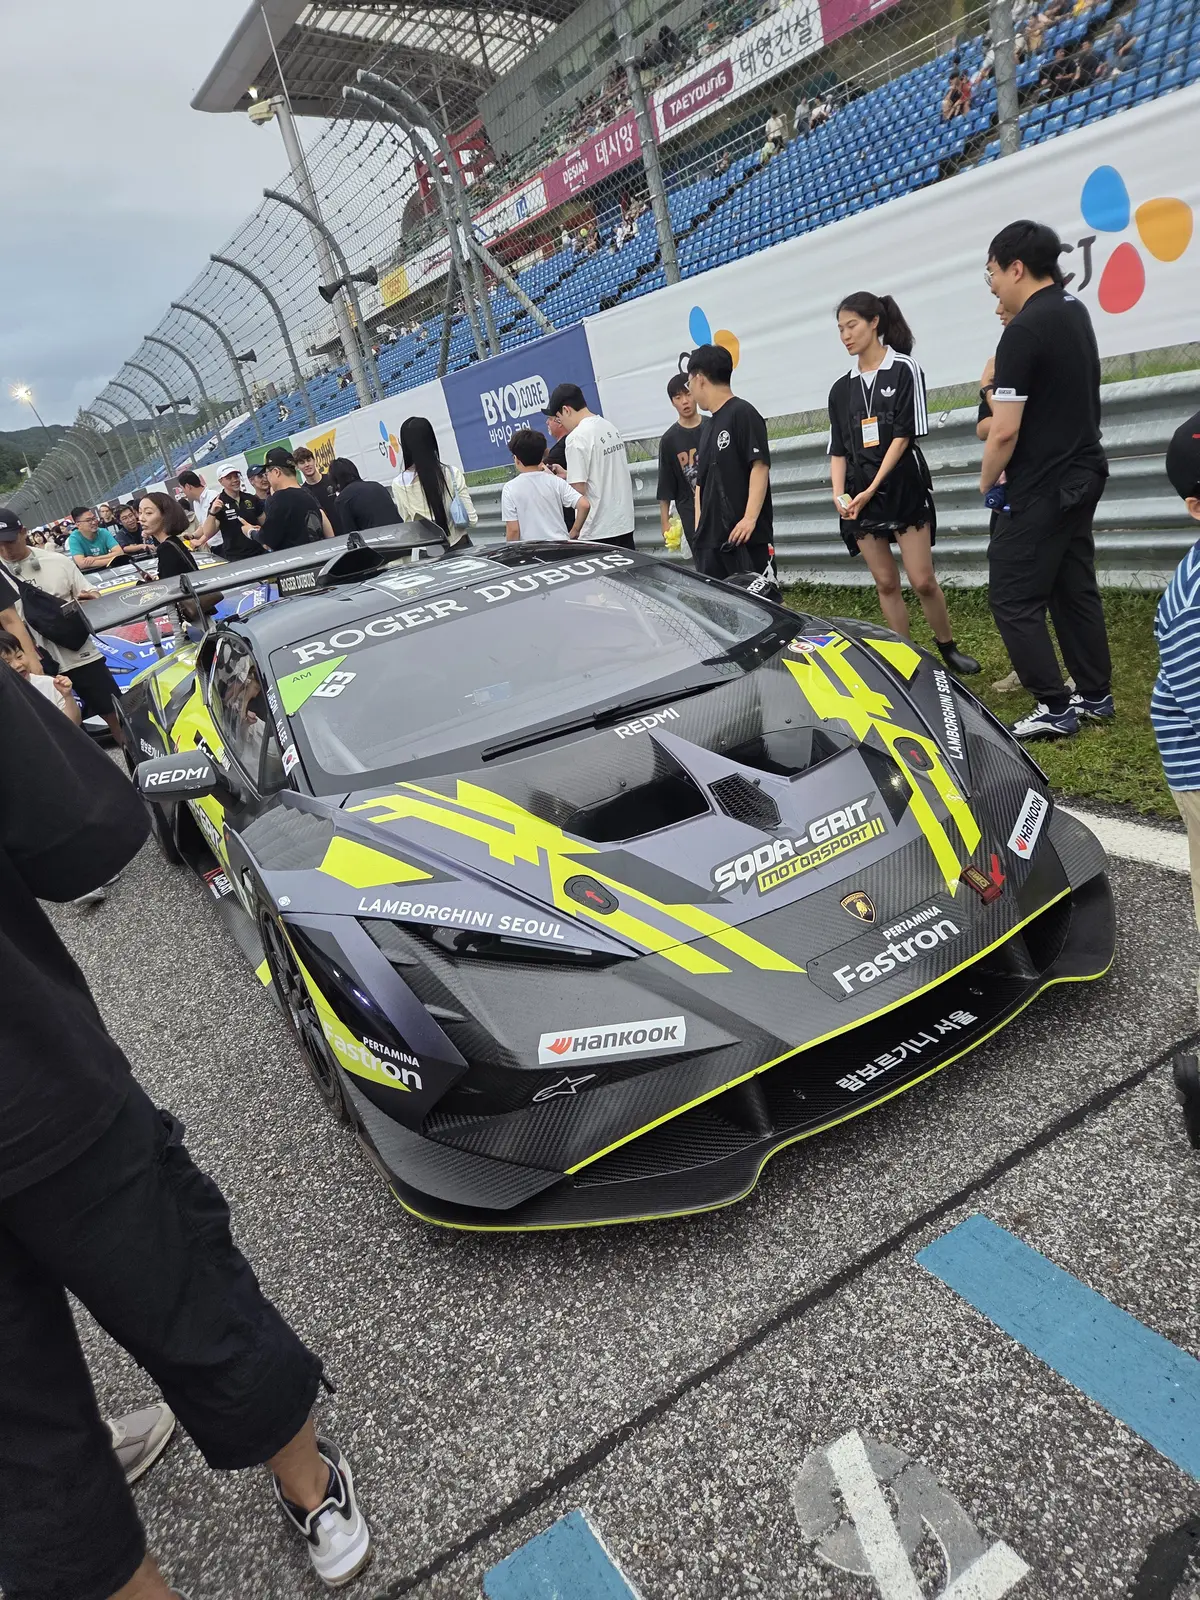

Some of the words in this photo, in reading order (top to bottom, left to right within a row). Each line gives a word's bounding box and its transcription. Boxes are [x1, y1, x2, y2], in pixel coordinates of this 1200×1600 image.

[739, 7, 813, 76] 태영건설
[669, 70, 727, 117] TAEYOUNG
[594, 122, 633, 167] 데시앙
[563, 157, 589, 185] DESIAN
[480, 384, 521, 426] BYO
[520, 382, 545, 409] CORE
[280, 577, 298, 592] ROGER
[297, 572, 316, 590] DUBUIS
[292, 598, 469, 665] ROGER
[473, 553, 635, 603] DUBUIS
[292, 671, 312, 683] AM
[311, 671, 357, 698] 63
[936, 669, 950, 696] SEOUL
[613, 707, 680, 740] REDMI
[939, 693, 964, 760] LAMBORGHINI
[145, 766, 209, 788] REDMI
[760, 825, 868, 891] MOTORSPORT
[357, 897, 493, 927] LAMBORGHINI
[498, 916, 565, 940] SEOUL
[882, 905, 942, 940] PERTAMINA
[832, 918, 960, 994] Fastron
[323, 1020, 423, 1091] Fastron
[362, 1036, 420, 1068] PERTAMINA
[835, 1031, 939, 1092] 람보르기니
[934, 1009, 978, 1036] 서울
